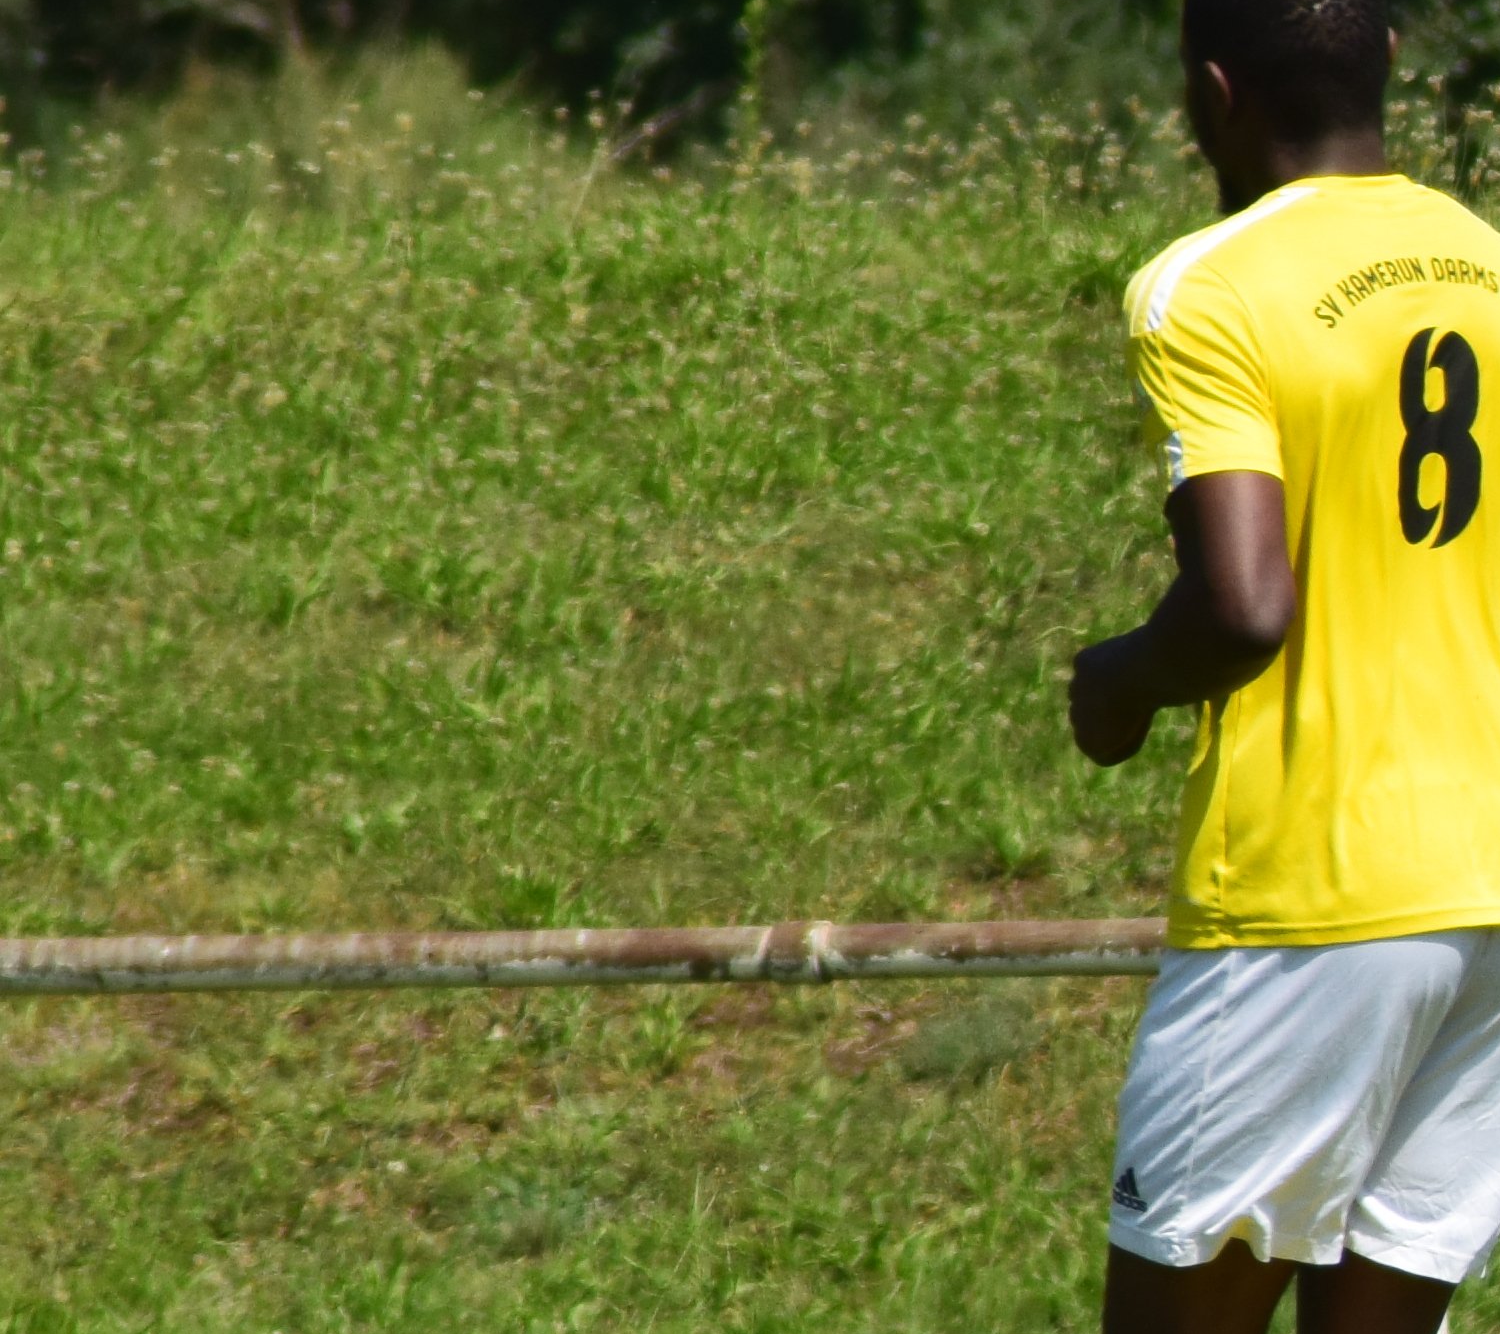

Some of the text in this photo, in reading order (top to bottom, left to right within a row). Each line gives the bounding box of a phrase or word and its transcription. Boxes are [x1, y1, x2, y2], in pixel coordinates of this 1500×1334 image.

[1314, 293, 1344, 329] SV
[1336, 257, 1426, 307] KAMERUN
[1397, 326, 1482, 549] 8
